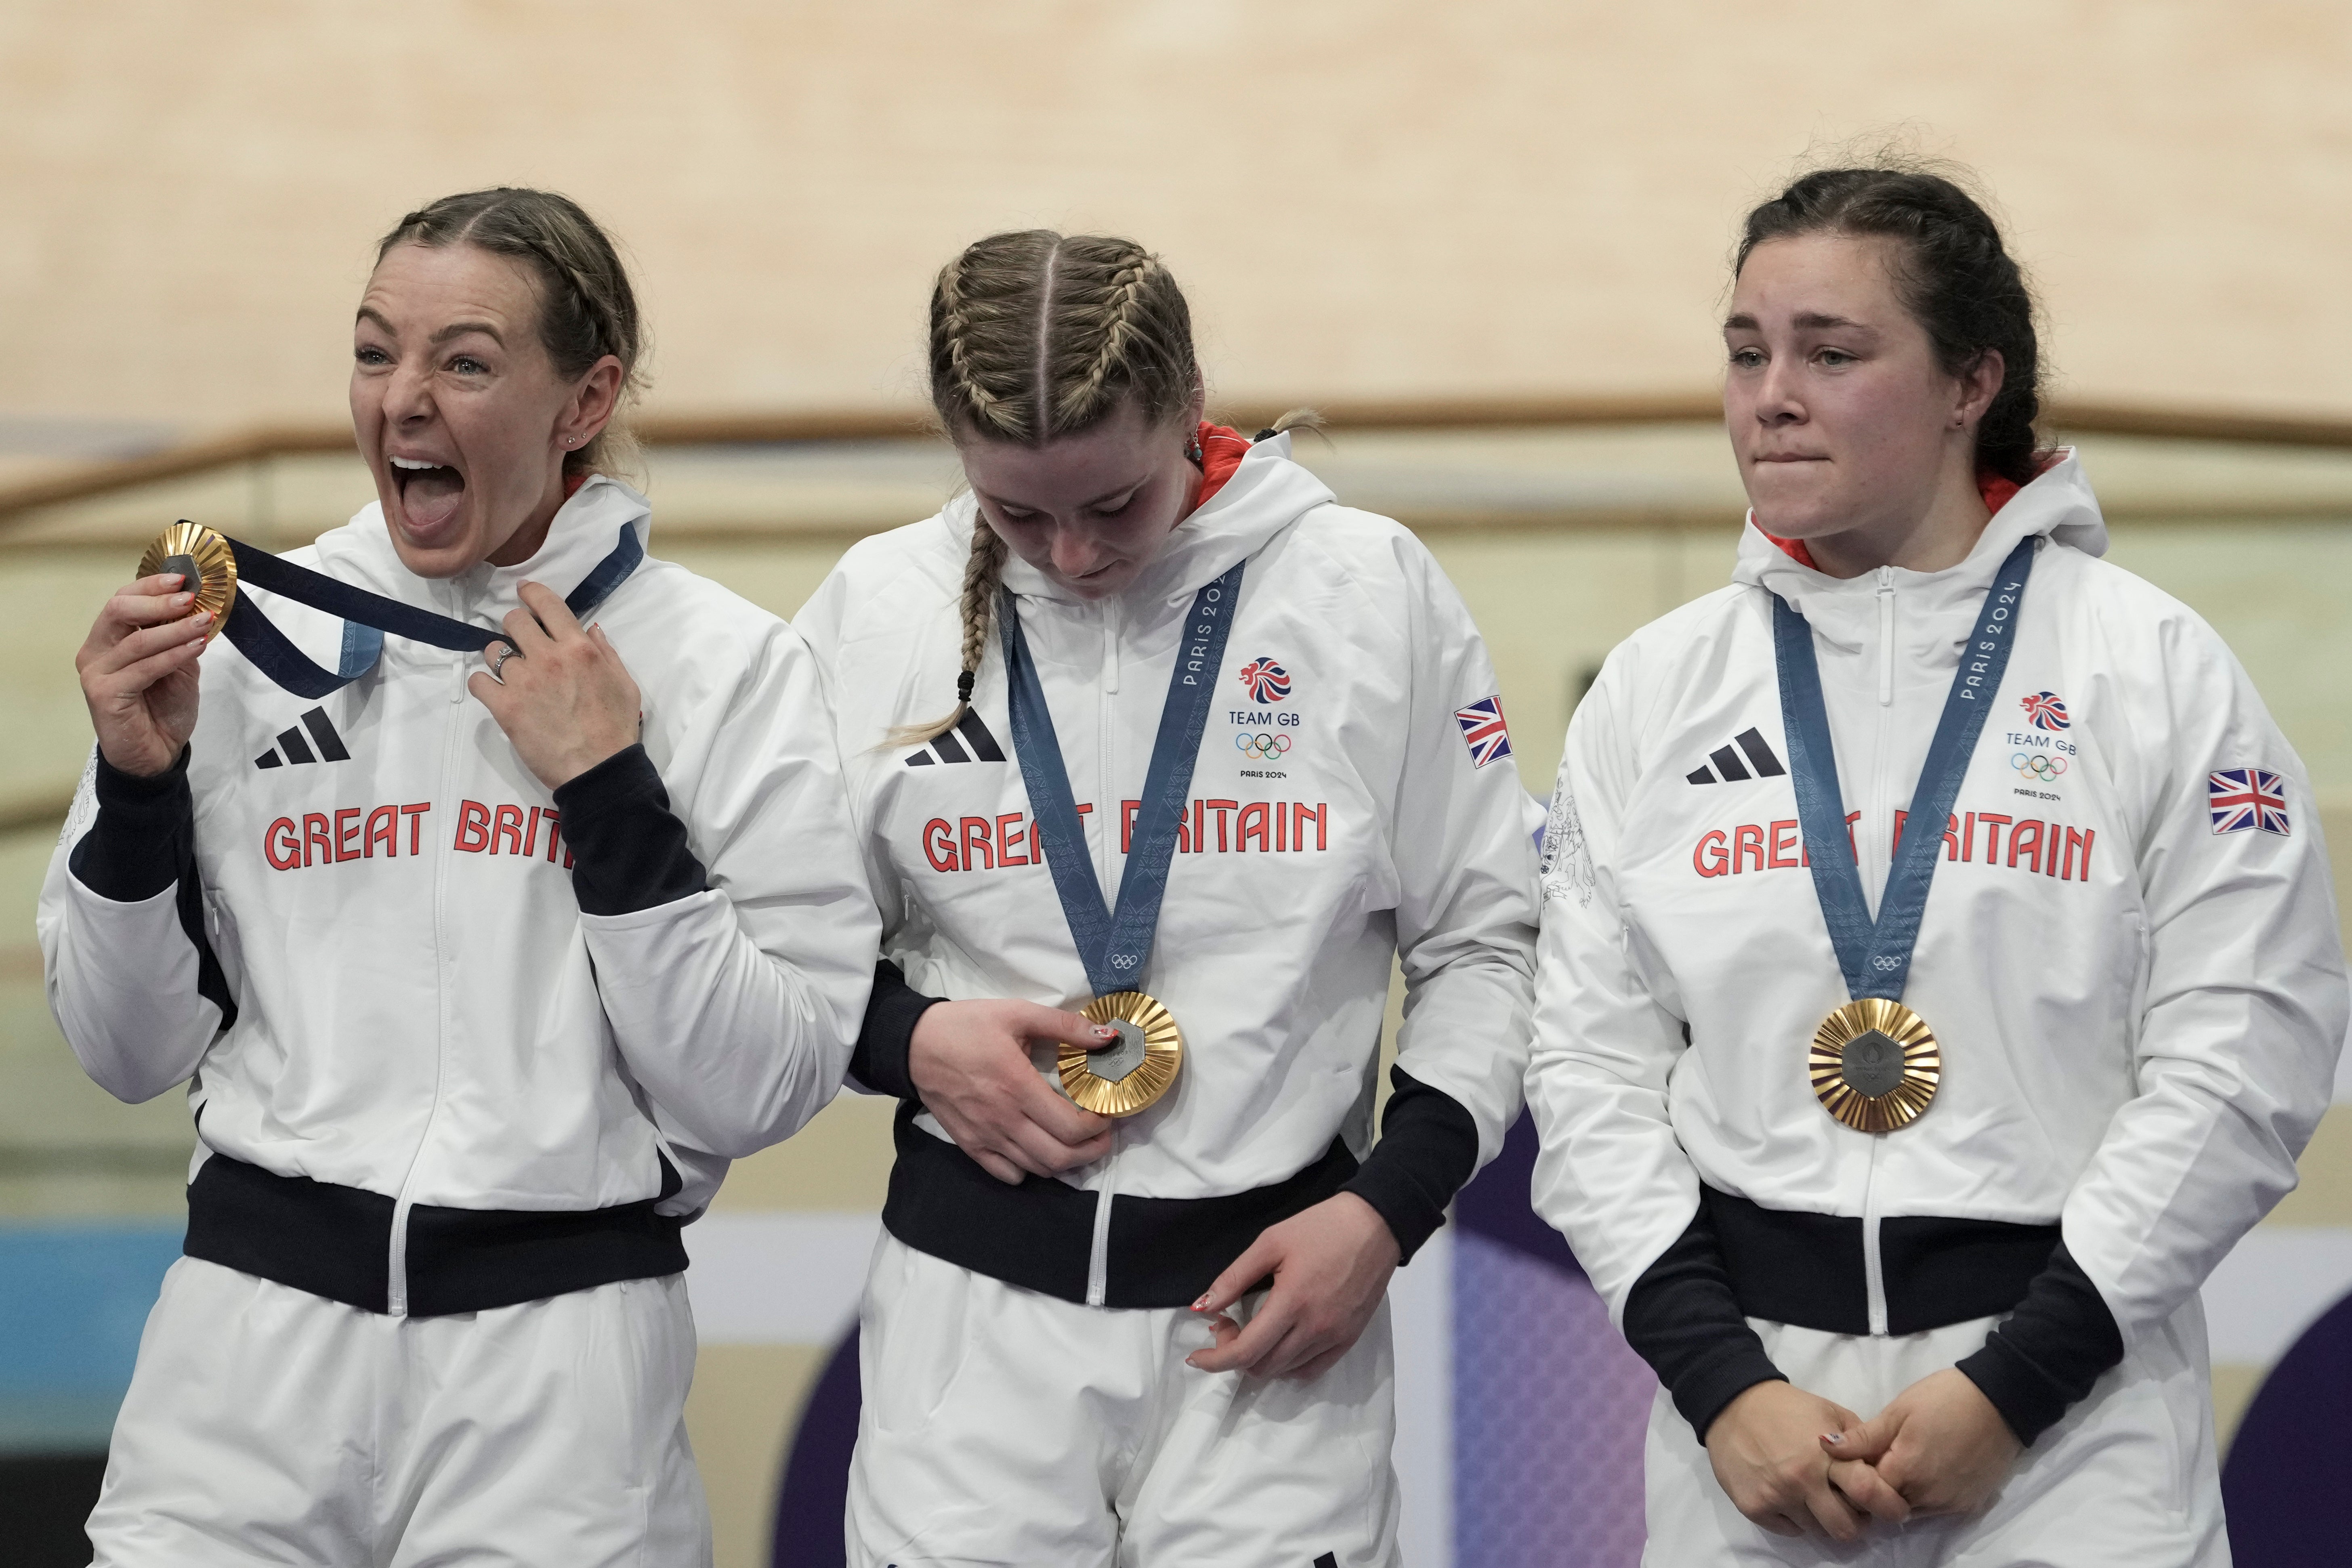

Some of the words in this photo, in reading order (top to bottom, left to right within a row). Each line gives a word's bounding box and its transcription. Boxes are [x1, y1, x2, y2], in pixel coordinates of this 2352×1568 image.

[1202, 575, 1226, 617] 202
[1986, 582, 2022, 635] 2024
[1229, 711, 1272, 725] TEAM
[1277, 713, 1300, 726] GB
[2006, 733, 2050, 748] TEAM
[2056, 740, 2077, 756] GB
[2039, 792, 2061, 802] 2024
[264, 801, 431, 871] GREAT
[454, 799, 573, 870] BRIT
[1693, 810, 1861, 878] GRET
